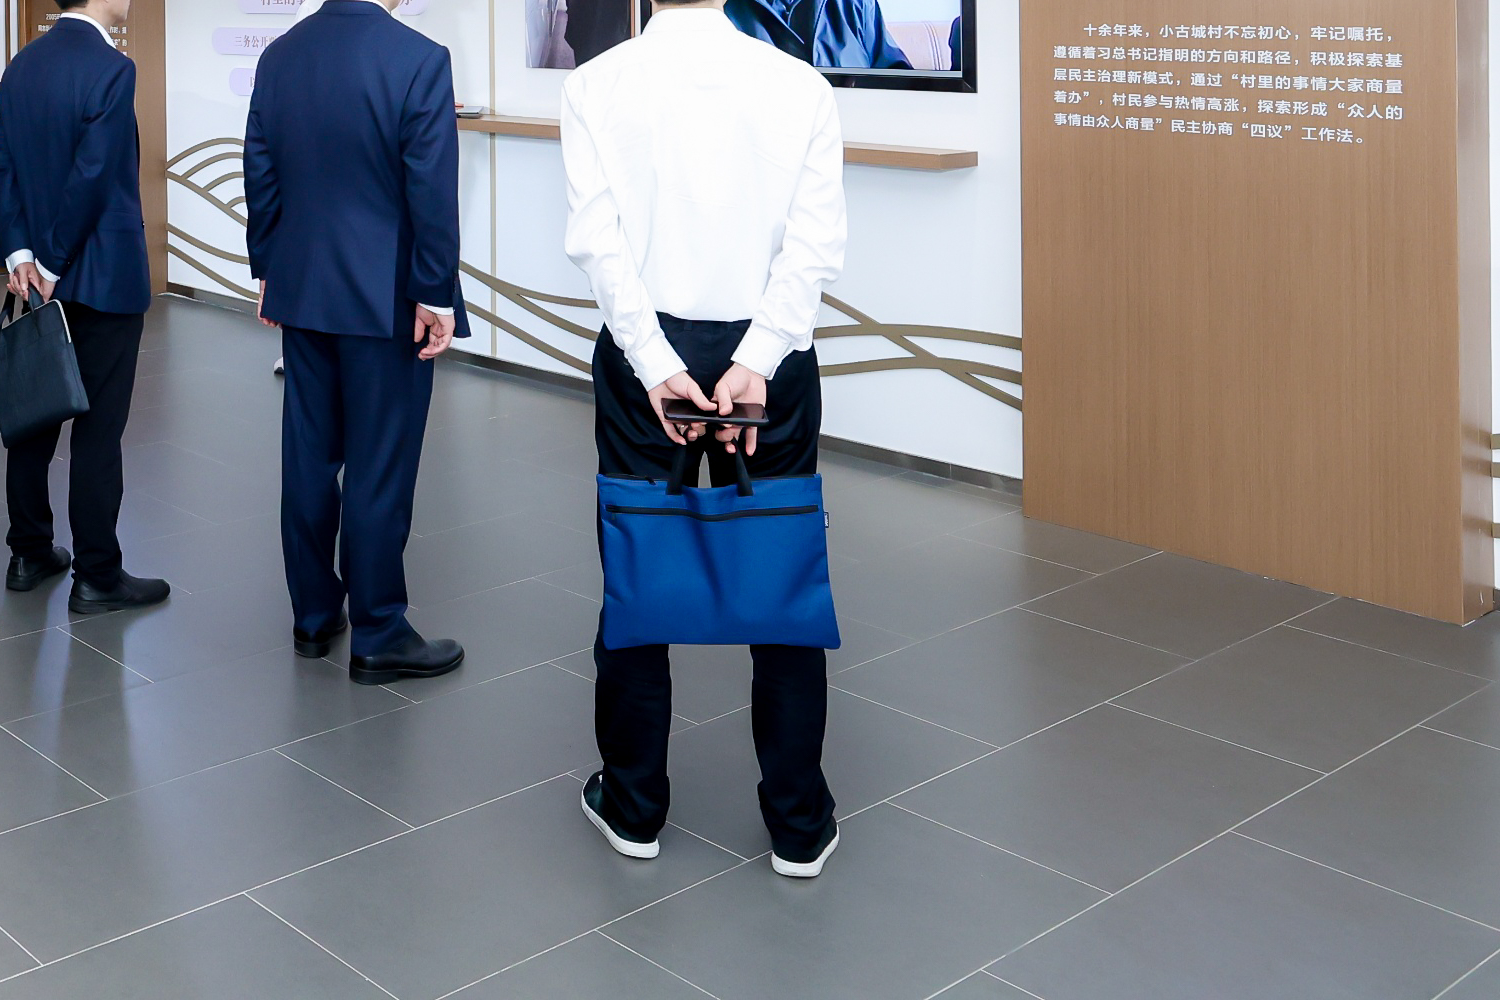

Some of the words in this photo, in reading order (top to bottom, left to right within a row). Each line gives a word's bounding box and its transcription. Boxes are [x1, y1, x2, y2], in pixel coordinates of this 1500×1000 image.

[1083, 23, 1395, 43] 十余年来，小古城村不忘初心，牢记嘱托，
[1053, 45, 1404, 68] 遵循着习总书记指明的方向和路径，积极探索基
[1053, 68, 1404, 95] 层民主治理新模式，通过“村里的事情大家商量
[1053, 89, 1404, 120] 着办”，村民参与热情高涨，探索形成“众人的
[1053, 113, 1365, 145] 事情由众人商量”民主协商“四议”工作法。
